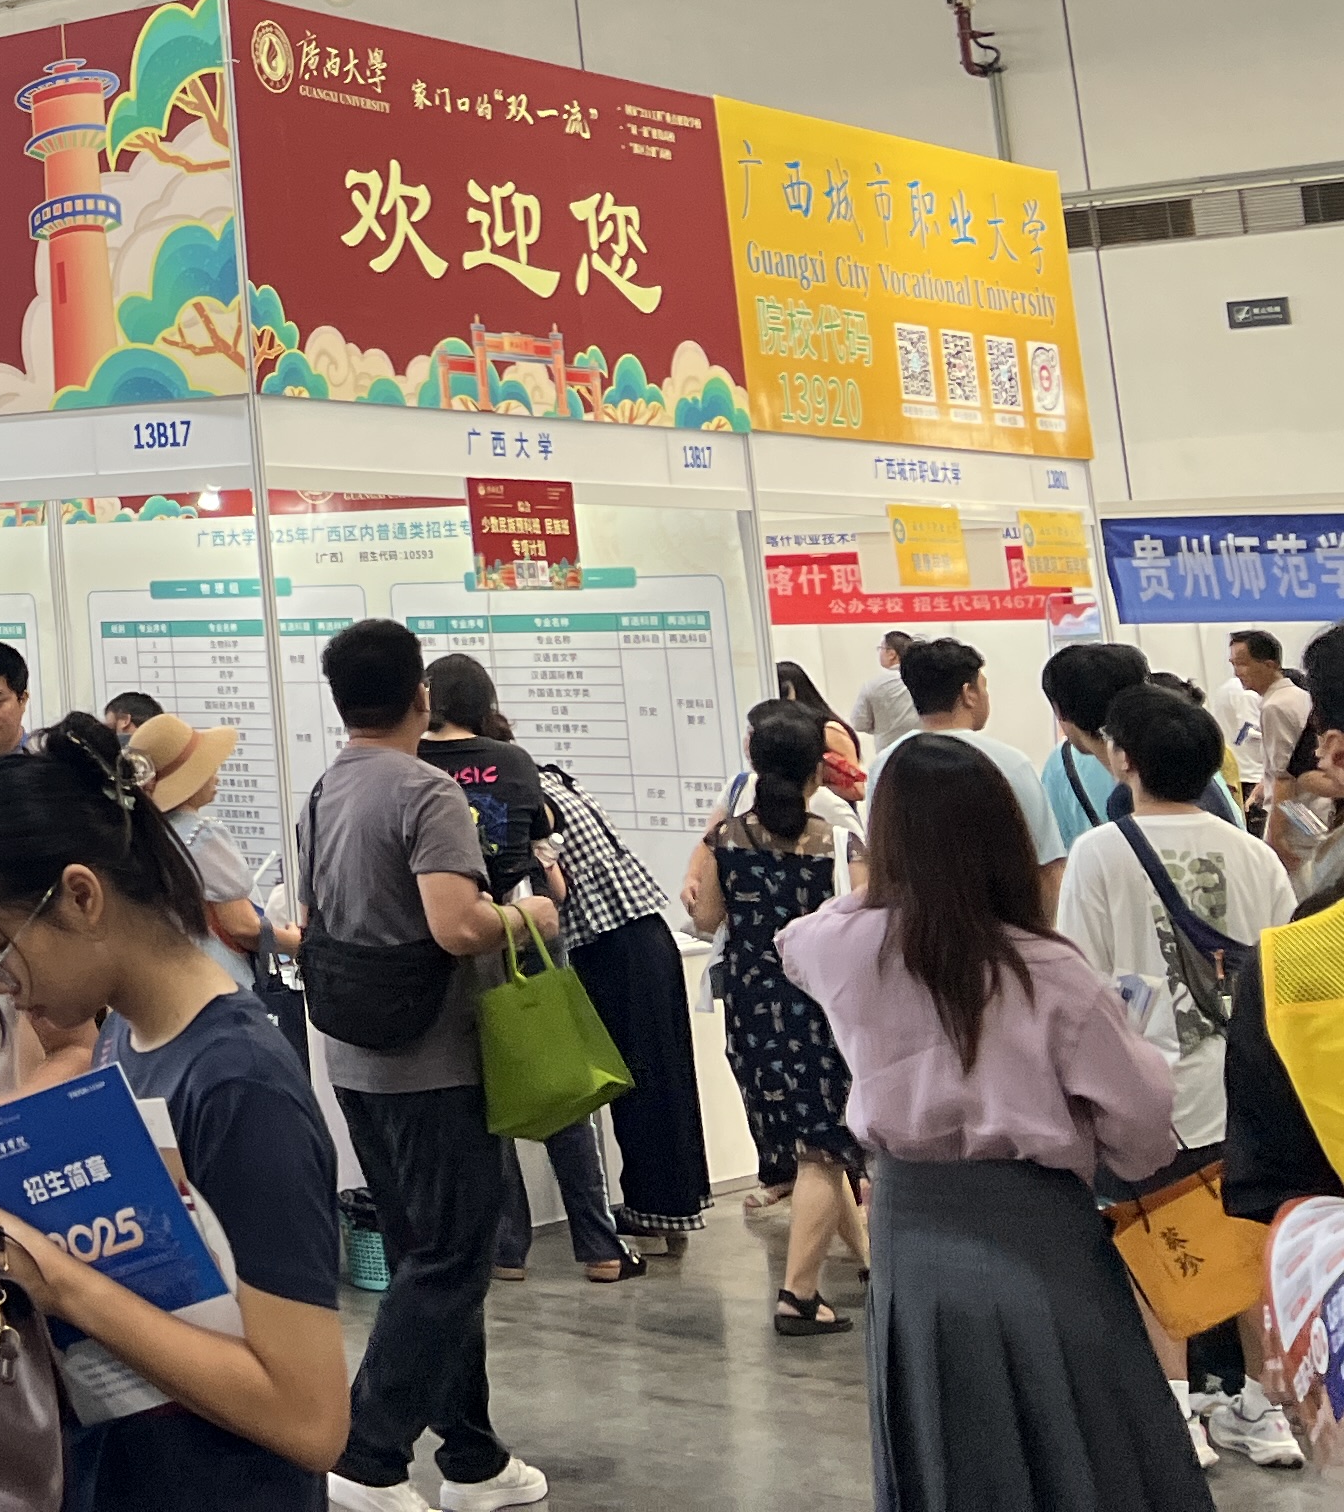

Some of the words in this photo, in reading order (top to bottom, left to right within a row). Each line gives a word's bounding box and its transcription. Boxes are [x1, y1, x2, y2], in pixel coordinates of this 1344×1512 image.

[299, 84, 338, 104] GUANGXI
[339, 91, 391, 114] UNIVERSITY
[738, 139, 1046, 274] 广西城市职业大学
[340, 159, 662, 314] 欢迎您
[746, 240, 826, 291] Guangxi
[835, 255, 870, 298] City
[878, 262, 972, 306] Vocational
[974, 279, 1057, 326] University
[755, 296, 873, 367] 院校代码
[778, 371, 863, 429] 13920
[133, 419, 192, 450] 13B17
[467, 428, 554, 460] 广西大学
[683, 445, 712, 469] 13B17
[874, 456, 962, 485] 广西城市职业大学
[511, 539, 547, 557] 专项计划
[766, 563, 862, 596] 喀什职
[828, 597, 904, 615] 公办学校
[914, 593, 1047, 613] 招生代码14677
[534, 617, 570, 628] 专业名称
[453, 636, 485, 646] 专业序号
[536, 635, 571, 645] 专业名称
[623, 634, 660, 644] 首选科目
[668, 633, 707, 643] 再选科目
[210, 640, 238, 649] 生物科学
[534, 653, 577, 663] 汉语言文学
[531, 670, 584, 680] 汉语国际教育
[217, 686, 239, 695] 经济学
[528, 688, 590, 698] 外国语言文学类
[204, 701, 255, 710] 国际经济与贸易
[676, 699, 714, 709] 不提科目
[551, 706, 568, 716] 日语
[639, 706, 658, 717] 历史
[687, 715, 706, 726] 要求
[535, 724, 589, 734] 新闻传播学类
[554, 741, 572, 751] 法学
[220, 794, 255, 803] 汉语言文学
[647, 788, 666, 799] 历史
[217, 810, 260, 819] 汉语国际教育
[650, 816, 669, 826] 历史
[23, 1155, 112, 1205] 招生简章
